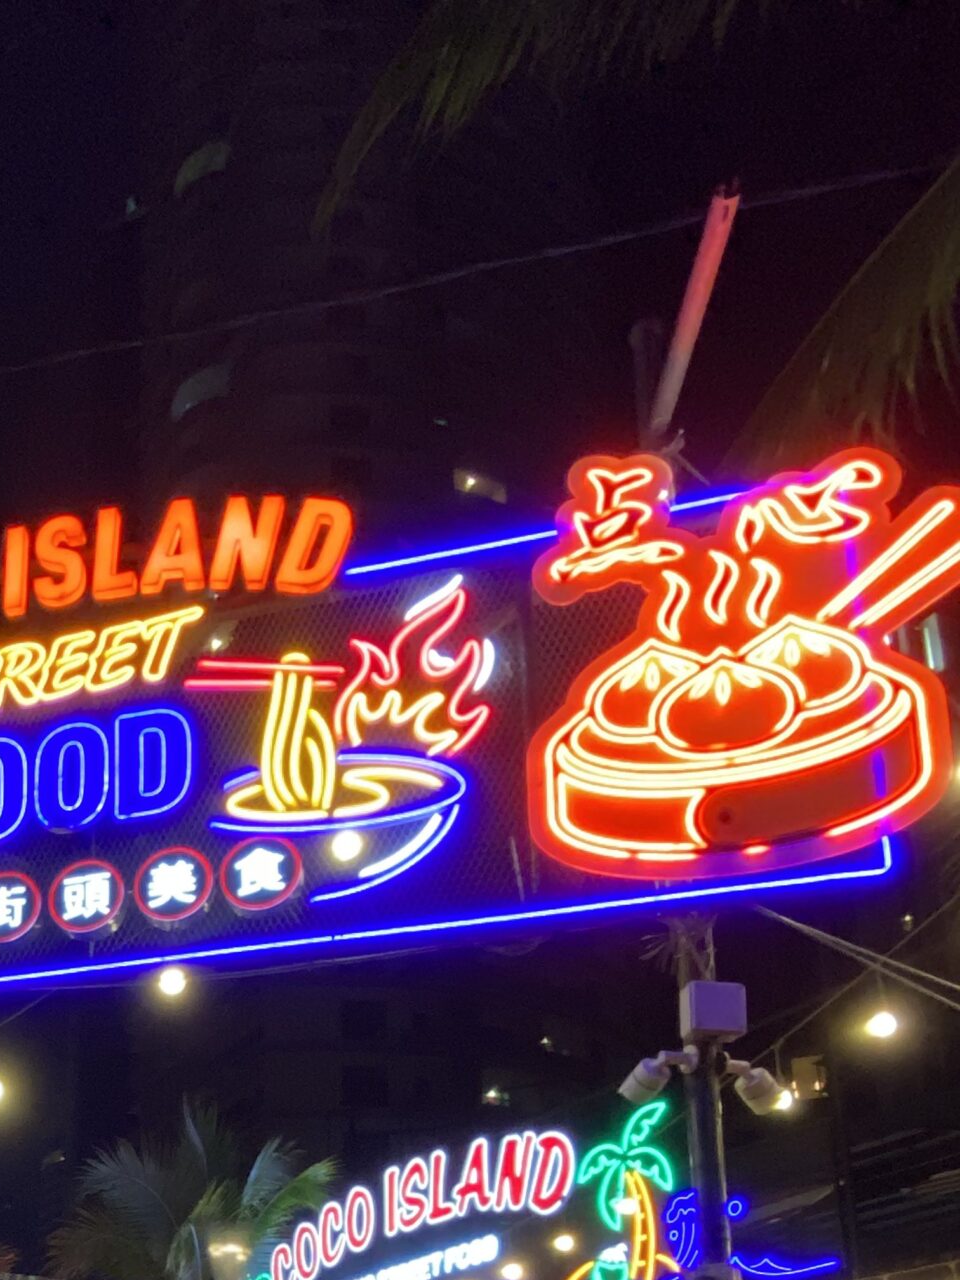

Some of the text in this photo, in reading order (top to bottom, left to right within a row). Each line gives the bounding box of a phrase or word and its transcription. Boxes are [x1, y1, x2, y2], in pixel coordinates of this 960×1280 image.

[3, 496, 353, 616] ISLAND
[550, 461, 882, 581] 点心
[384, 1130, 577, 1237] ISLAND
